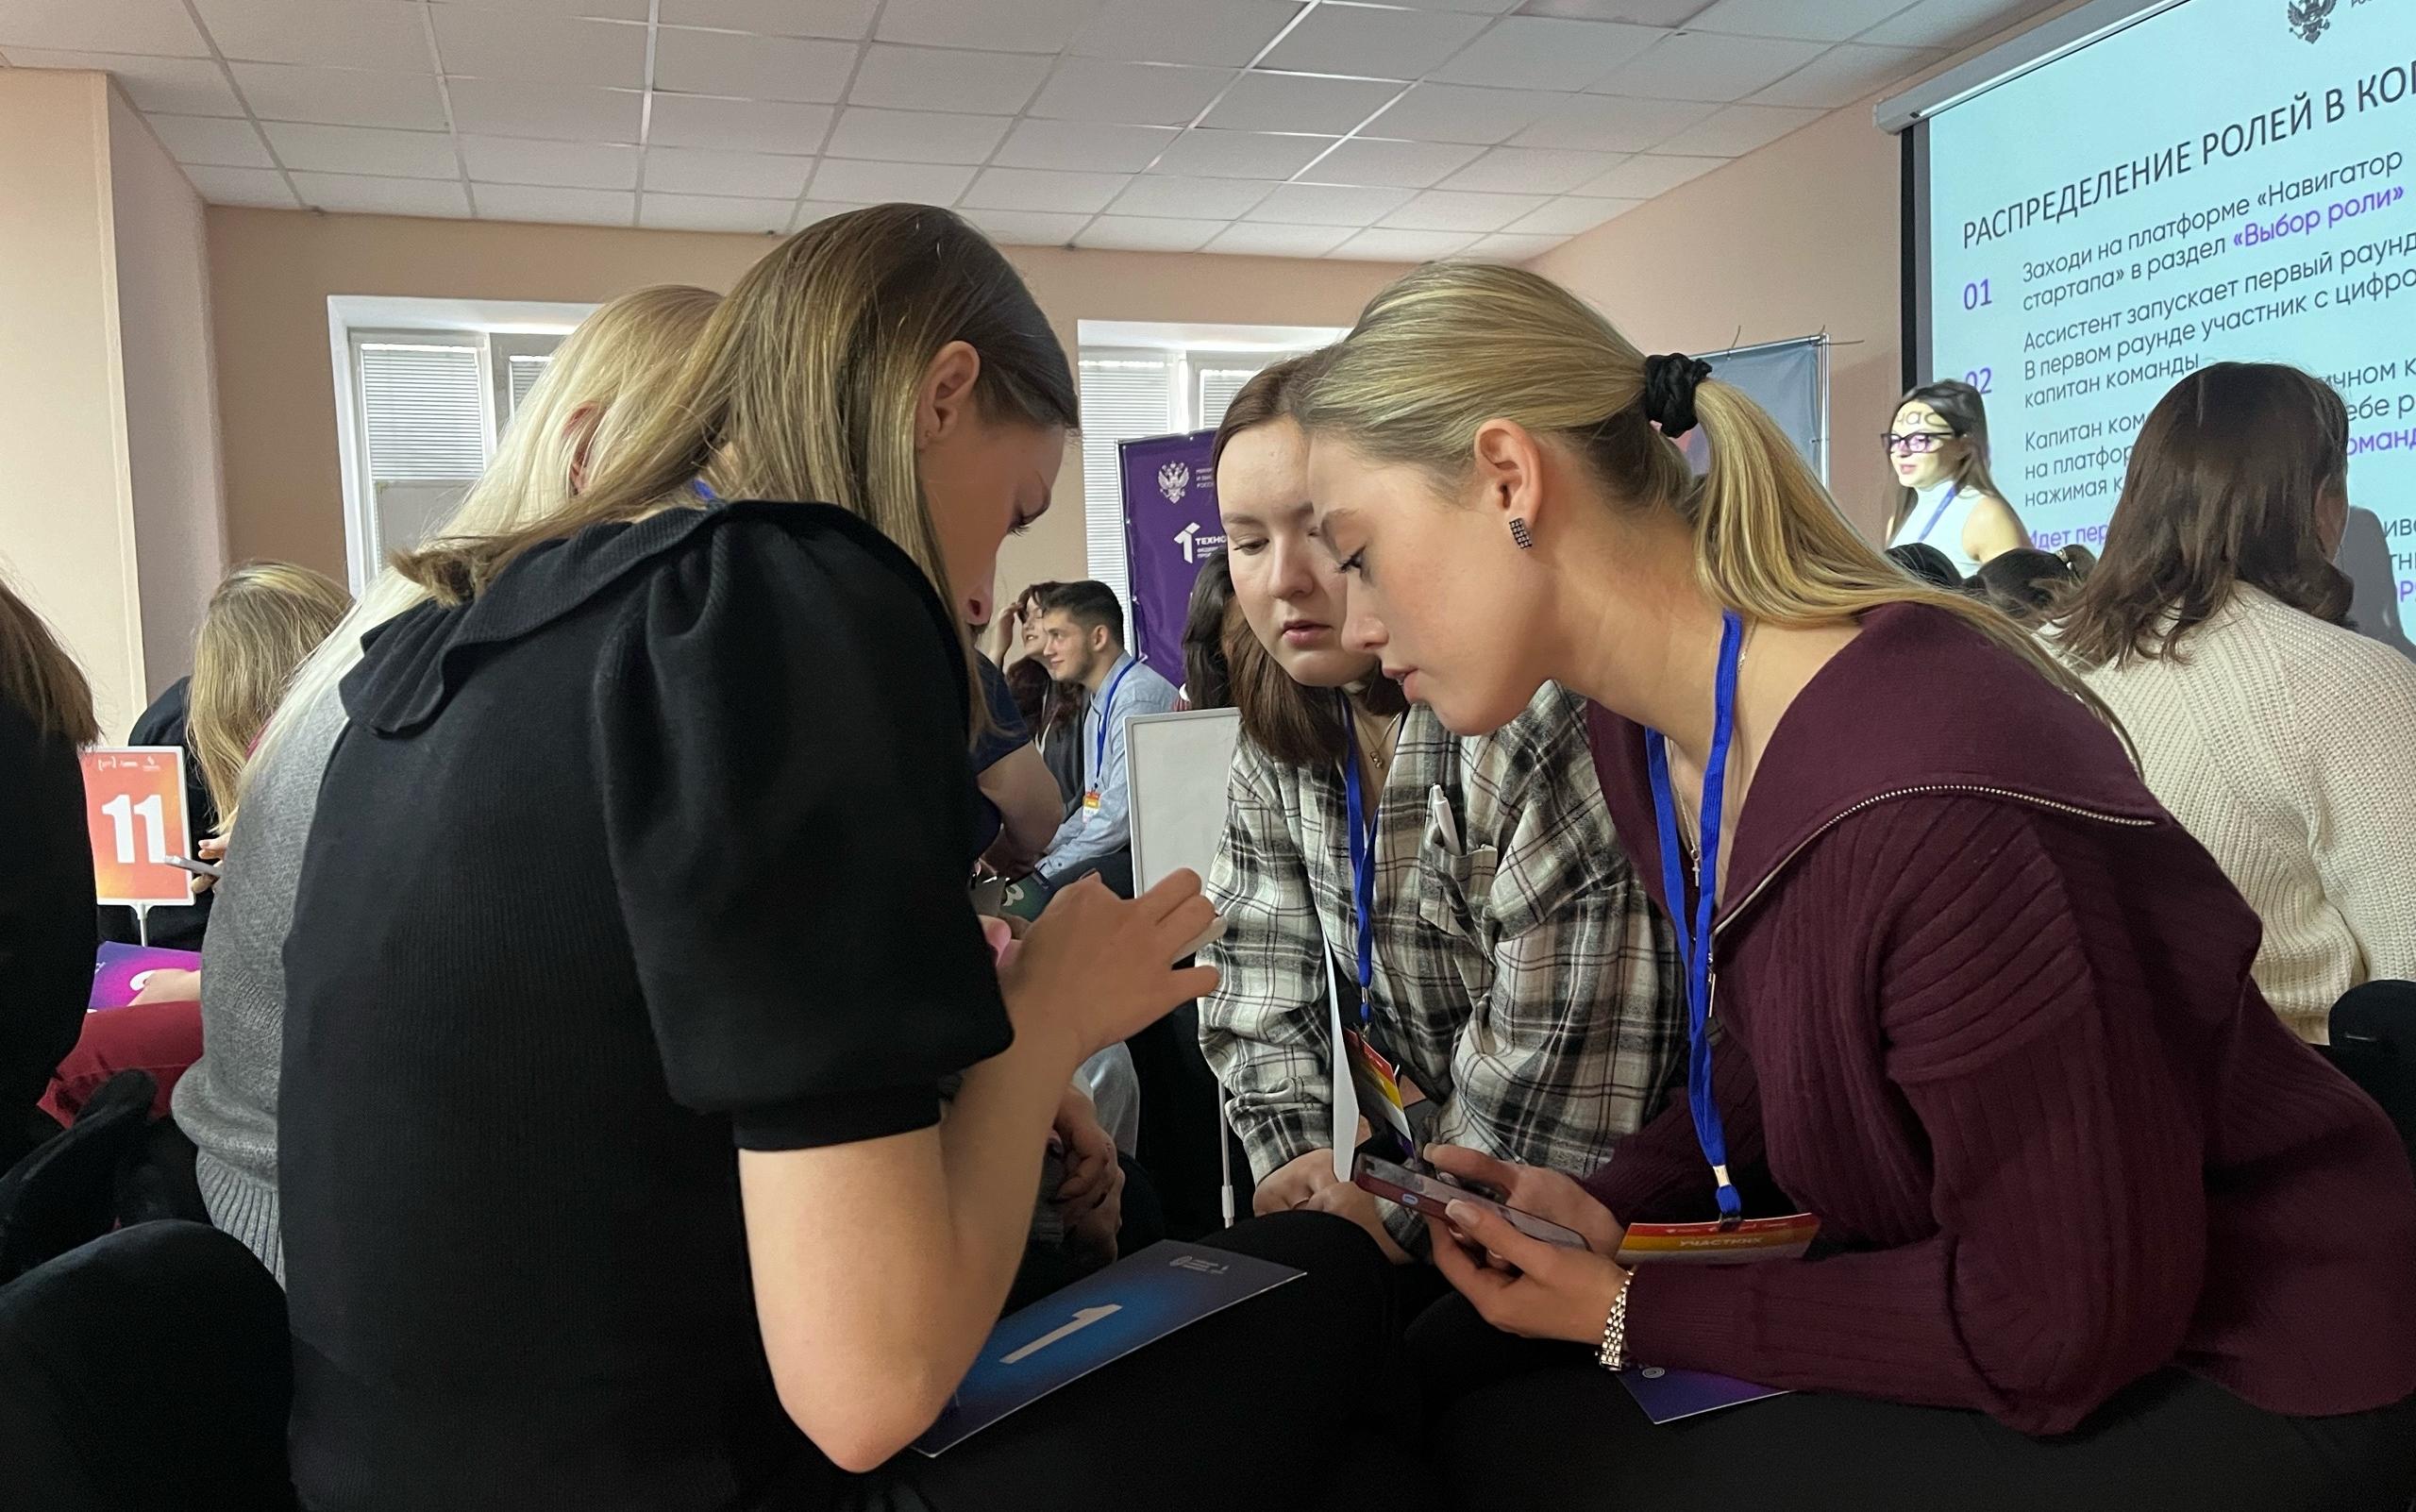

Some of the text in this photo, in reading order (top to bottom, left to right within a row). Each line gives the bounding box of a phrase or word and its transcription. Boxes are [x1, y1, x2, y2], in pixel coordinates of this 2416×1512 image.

[1963, 60, 2416, 249] РАСПРЕДЕЛЕНИЕ РОЛЕЙ В КО
[2022, 151, 2403, 283] Заходи на платформе «Навигатор
[2023, 186, 2404, 311] стартапа» в раздел «Выбор роли»
[1964, 278, 1992, 311] 01
[2023, 231, 2416, 353] Ассистент запускает первый раунд
[2024, 361, 2035, 380] В
[2040, 344, 2110, 377] первом
[2117, 323, 2195, 361] раунде
[2202, 295, 2307, 342] участник
[2314, 291, 2328, 309] с
[1966, 367, 1992, 395] 02
[2025, 353, 2199, 408] капитан команды
[2025, 422, 2102, 451] Капитан
[2025, 462, 2048, 479] на
[2025, 479, 2107, 507] нажимая
[102, 795, 166, 864] 11
